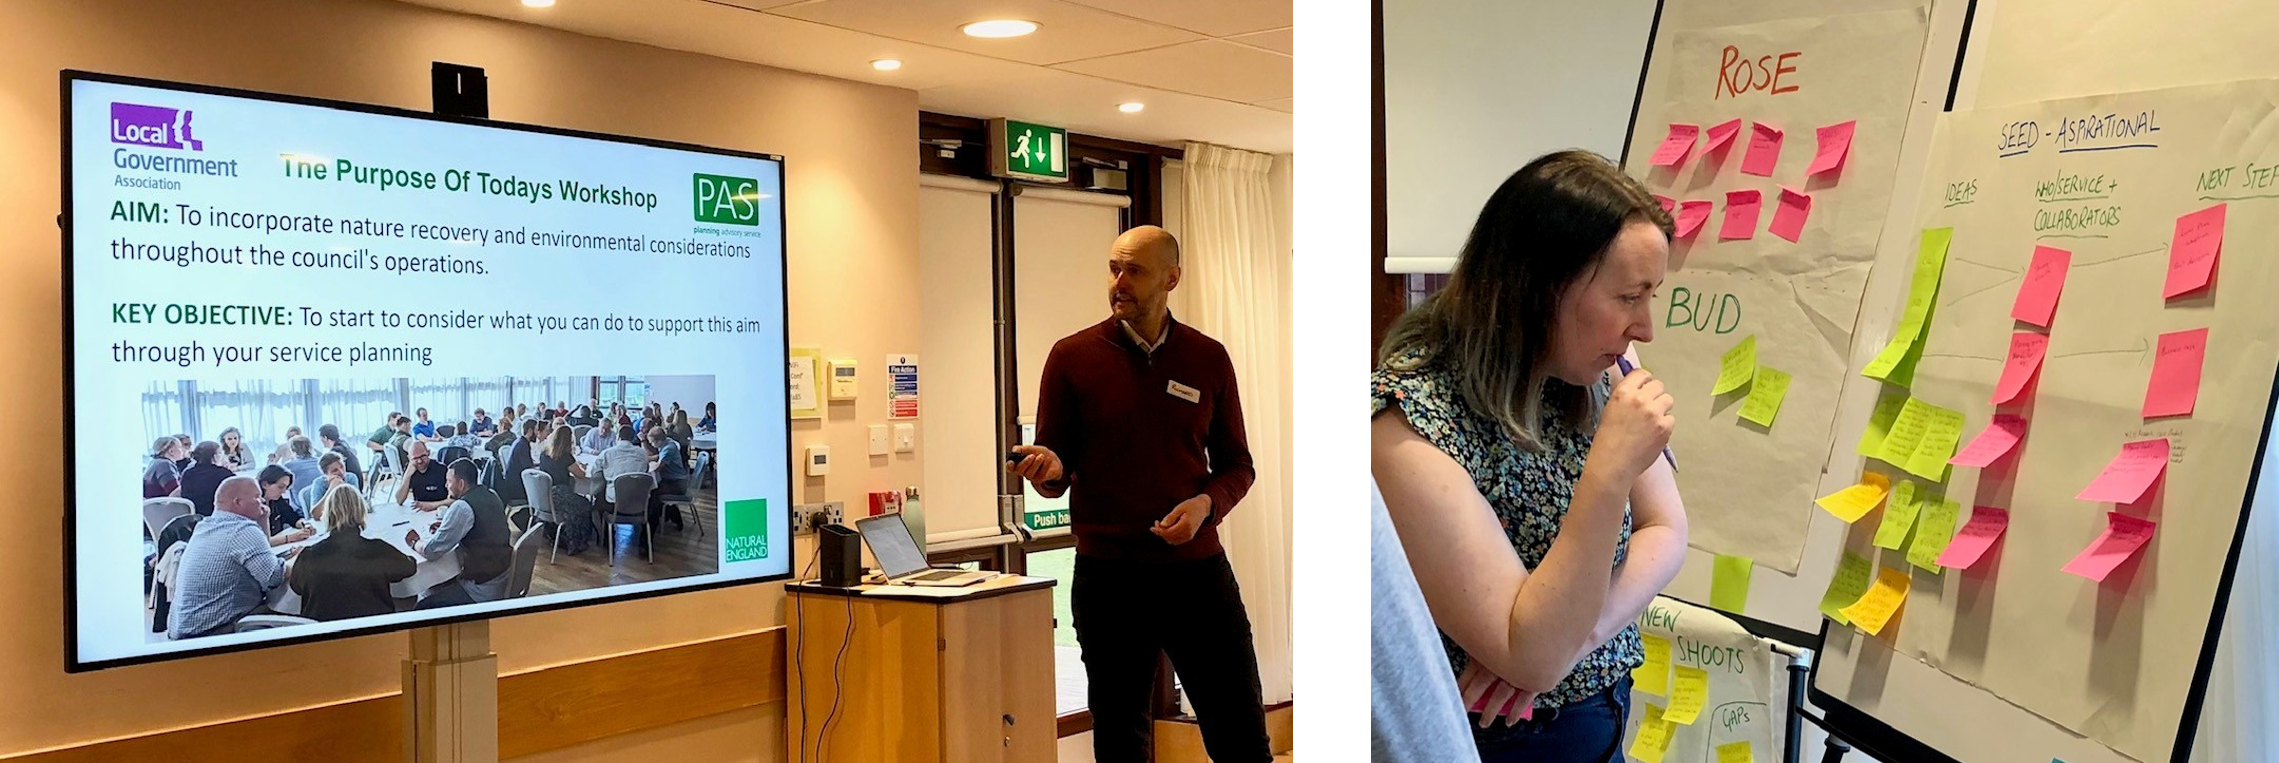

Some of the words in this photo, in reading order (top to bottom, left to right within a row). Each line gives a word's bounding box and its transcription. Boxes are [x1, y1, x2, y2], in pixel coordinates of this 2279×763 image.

[1715, 45, 1802, 100] ROSE
[113, 118, 168, 144] Local
[1998, 121, 2039, 151] SEED
[2055, 110, 2160, 148] ASPIRATIONAL
[113, 148, 238, 178] Government
[114, 175, 181, 191] Association
[280, 153, 327, 181] The
[337, 159, 436, 190] Purpose
[444, 168, 470, 192] Of
[477, 172, 552, 203] Todays
[559, 180, 657, 213] Workshop
[1944, 179, 1978, 202] IDEAS
[2196, 166, 2236, 192] NEXT
[698, 178, 755, 221] PAS
[111, 200, 169, 224] AIM:
[176, 204, 202, 227] To
[210, 207, 333, 234] incorporate
[340, 216, 404, 238] nature
[411, 222, 489, 247] recovery
[494, 226, 526, 245] and
[531, 232, 646, 252] environmental
[650, 236, 751, 259] considerations
[693, 226, 720, 237] planning
[721, 228, 743, 239] advisory
[2034, 206, 2122, 232] COLLABORATORS
[111, 238, 243, 267] throughout
[250, 244, 285, 266] the
[292, 248, 379, 270] council's
[385, 252, 489, 276] operations.
[112, 303, 157, 324] KEY
[164, 304, 293, 326] OBJECTIVE:
[299, 306, 323, 327] To
[329, 308, 375, 328] start
[381, 310, 401, 328] to
[407, 310, 484, 329] consider
[489, 311, 533, 330] what
[537, 316, 567, 334] you
[572, 317, 600, 331] can
[604, 313, 624, 332] do
[628, 315, 644, 332] to
[648, 315, 704, 336] support
[707, 315, 733, 333] this
[736, 316, 760, 334] aim
[1666, 286, 1741, 334] BUD
[112, 340, 205, 367] through
[212, 343, 263, 367] your
[269, 342, 343, 363] service
[349, 342, 433, 366] planning
[1034, 512, 1057, 527] Push
[1058, 510, 1070, 525] ba
[726, 534, 767, 549] NATURAL
[726, 546, 767, 560] ENGLAND
[1640, 605, 1682, 633] NEW
[1677, 635, 1744, 674] SHOOTS
